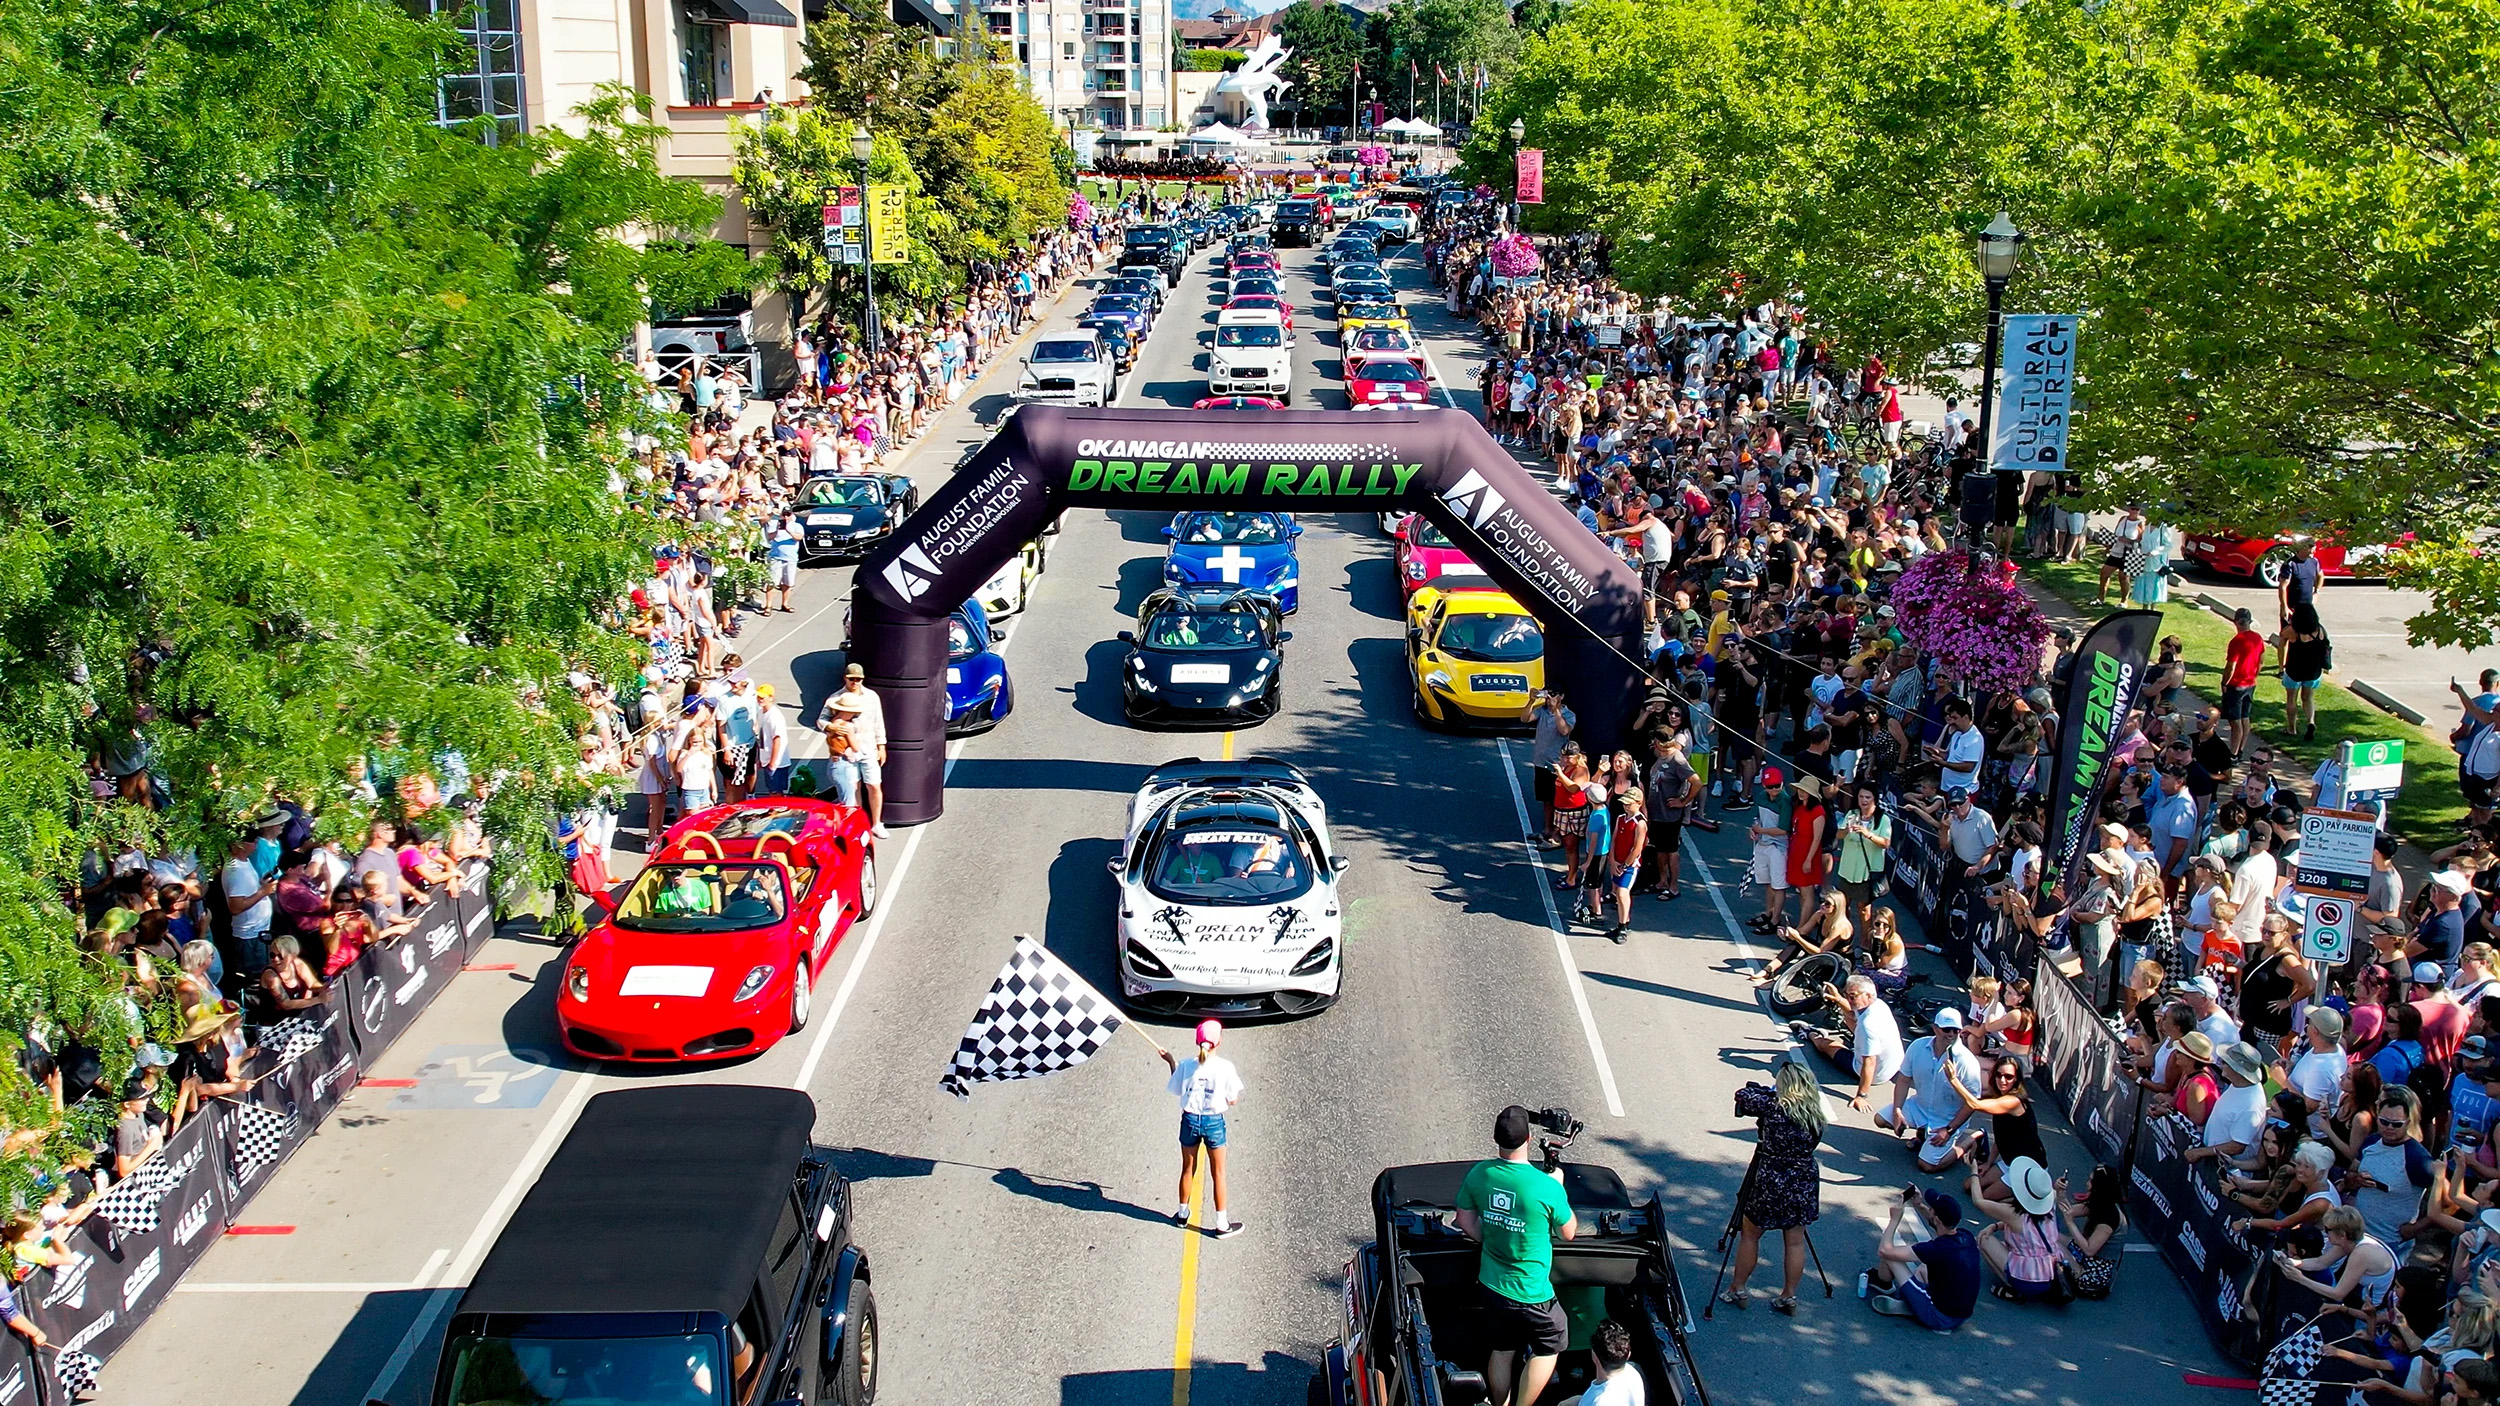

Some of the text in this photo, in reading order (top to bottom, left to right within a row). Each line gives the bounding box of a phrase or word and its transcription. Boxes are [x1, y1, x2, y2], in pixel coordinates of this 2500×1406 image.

[881, 190, 894, 260] CULTURAL
[892, 190, 904, 259] DISTRICT
[2016, 323, 2048, 462] CULTURAL
[2038, 322, 2069, 462] DISTRICT
[1077, 439, 1208, 459] OKANAGAN
[1068, 460, 1422, 496] DREAM RALLY
[920, 457, 1015, 550] AUGUST FAMILY
[931, 474, 1030, 564] FOUNDATION
[1484, 520, 1584, 614] FOUNDATION
[1500, 508, 1600, 600] AUGUST FAMILY
[1478, 678, 1521, 686] AUGUST
[2074, 650, 2120, 789] DREAM
[2326, 820, 2373, 834] PAY PARKING
[2298, 873, 2328, 885] 3208
[1194, 924, 1265, 934] DREAM
[1199, 934, 1260, 943] RALLY
[1172, 963, 1219, 974] Hard Rock
[1240, 966, 1288, 978] Hard Rock
[2152, 1192, 2172, 1219] RALLY
[2182, 1220, 2207, 1264] CASE
[122, 1246, 160, 1297] CASE
